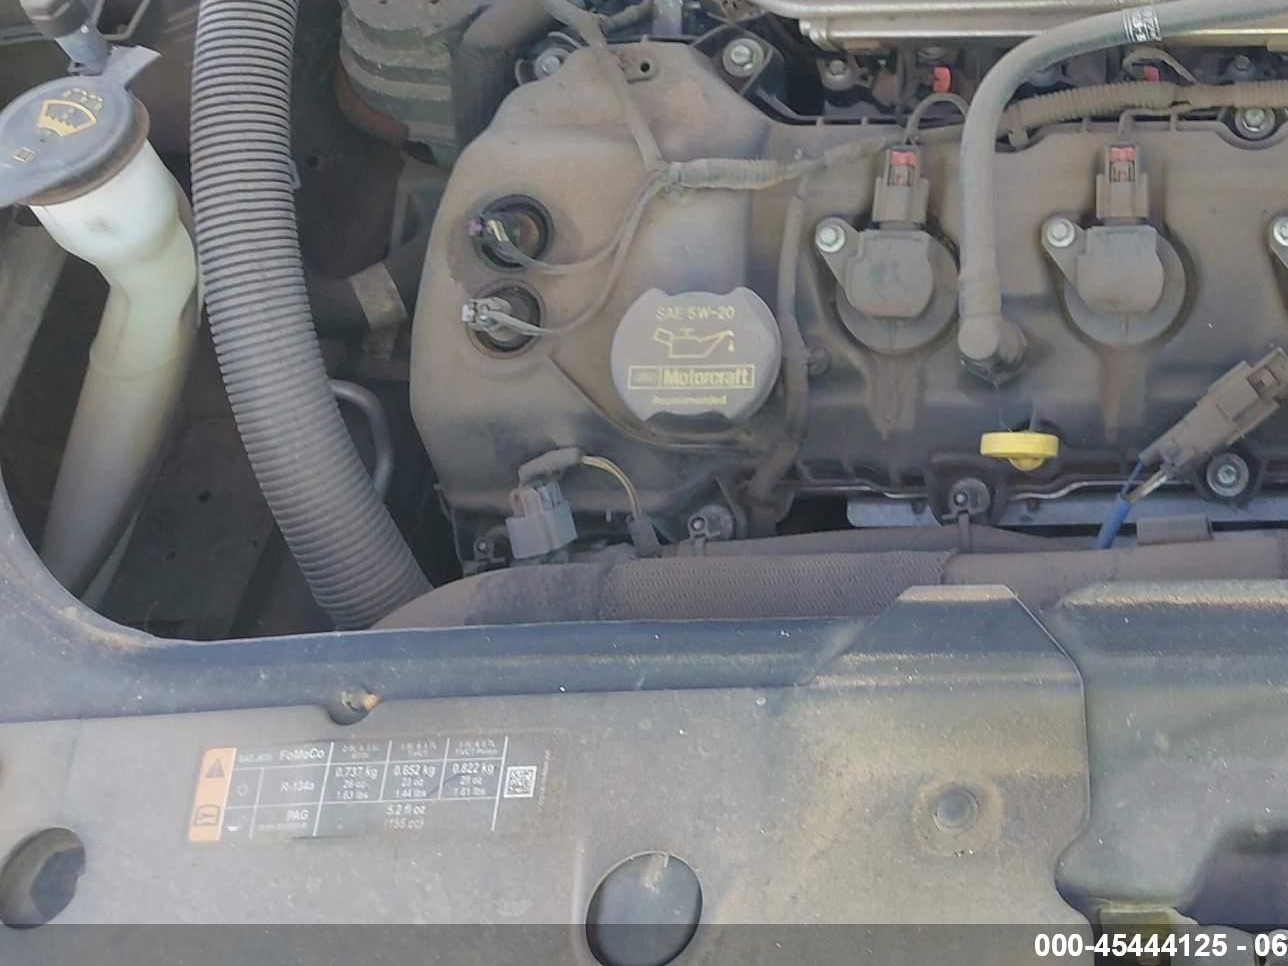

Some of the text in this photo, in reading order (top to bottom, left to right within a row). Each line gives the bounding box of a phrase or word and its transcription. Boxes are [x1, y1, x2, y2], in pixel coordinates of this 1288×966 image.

[655, 304, 736, 321] SAE 5W-20
[663, 367, 749, 385] Motorcraft
[279, 746, 326, 762] FoMoCo
[366, 766, 378, 780] kg
[422, 763, 436, 778] kg
[481, 761, 495, 775] kg
